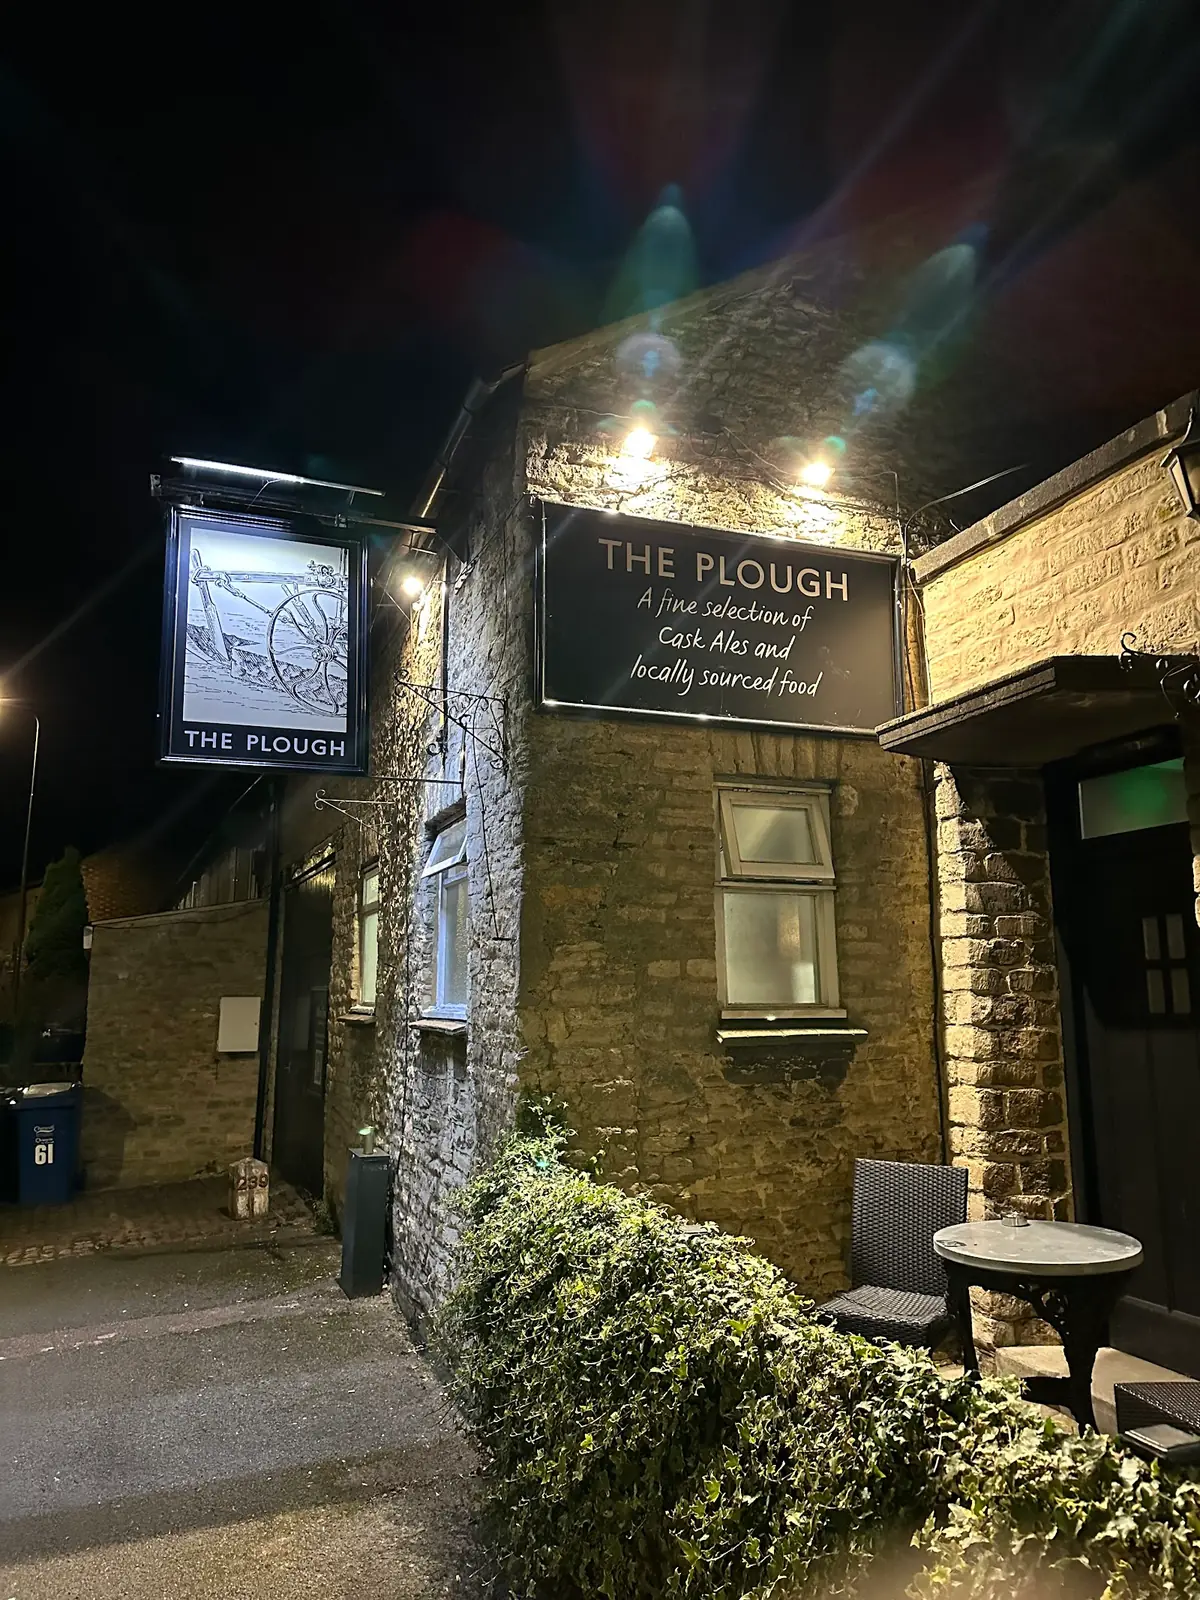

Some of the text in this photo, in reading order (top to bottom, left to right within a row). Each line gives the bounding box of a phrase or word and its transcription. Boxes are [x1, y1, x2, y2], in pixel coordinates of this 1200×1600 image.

[598, 538, 849, 602] THE PLOUGH
[637, 587, 815, 632] A fine selection of
[659, 626, 796, 661] Cask Ales and
[630, 654, 823, 698] locally sourced food
[184, 730, 346, 757] THE PLOUGH
[34, 1144, 54, 1165] 61
